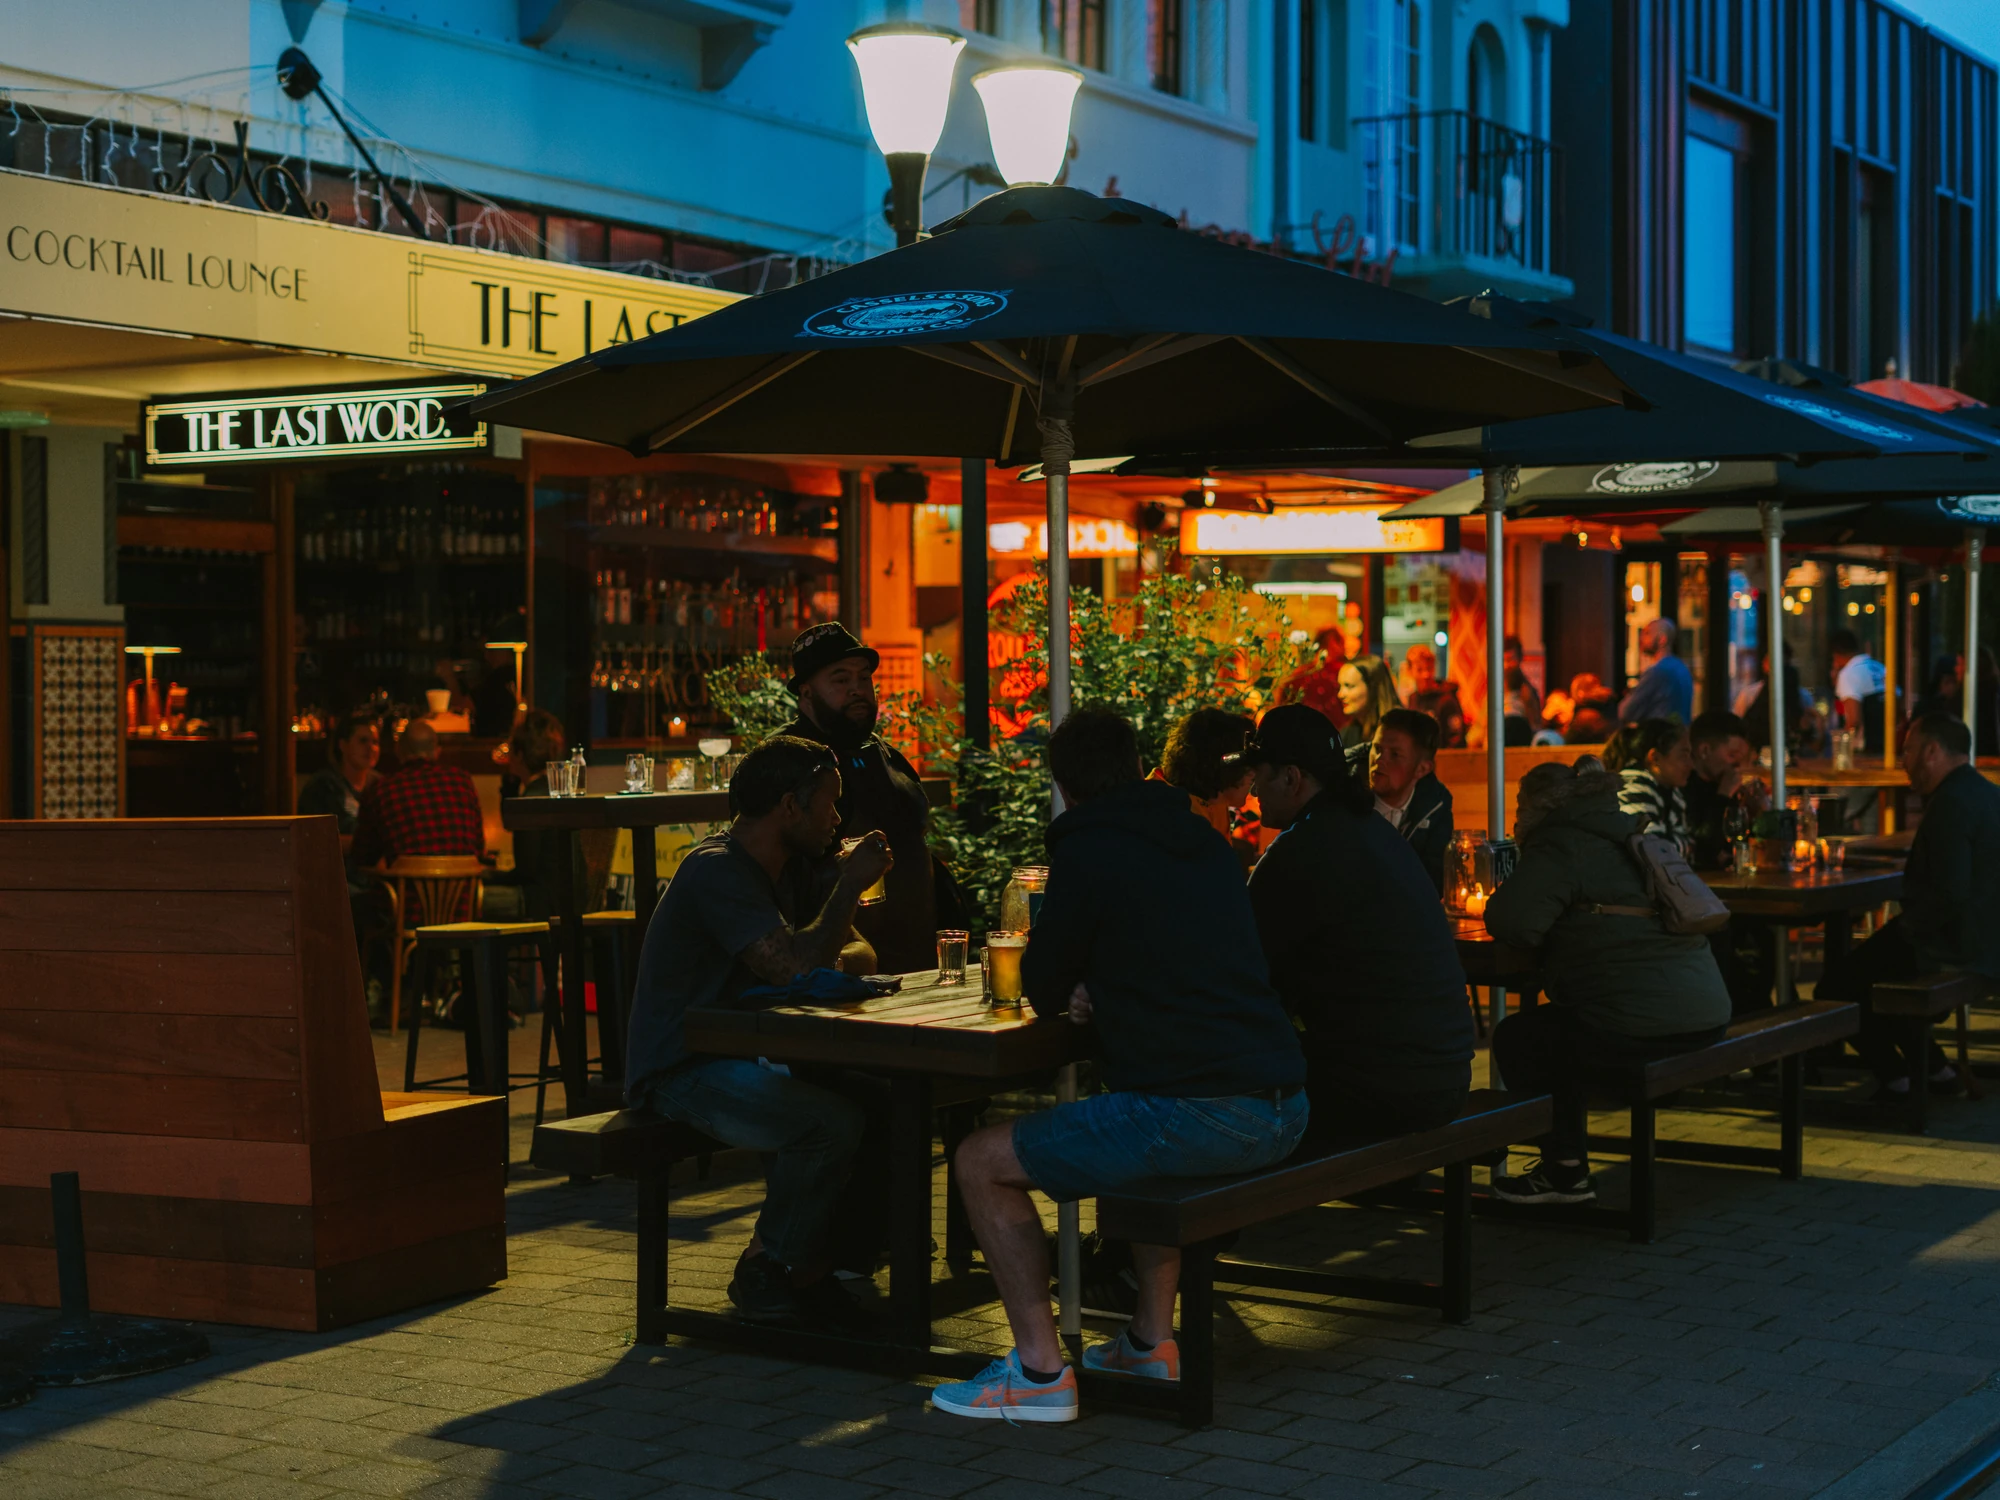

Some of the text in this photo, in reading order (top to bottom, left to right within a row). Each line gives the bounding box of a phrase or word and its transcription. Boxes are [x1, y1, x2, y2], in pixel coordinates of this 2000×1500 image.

[6, 225, 309, 302] COCKTAIL LOUNGE
[470, 281, 559, 356] THE
[816, 324, 925, 337] BREWING
[182, 398, 452, 452] THE LAST WORD.
